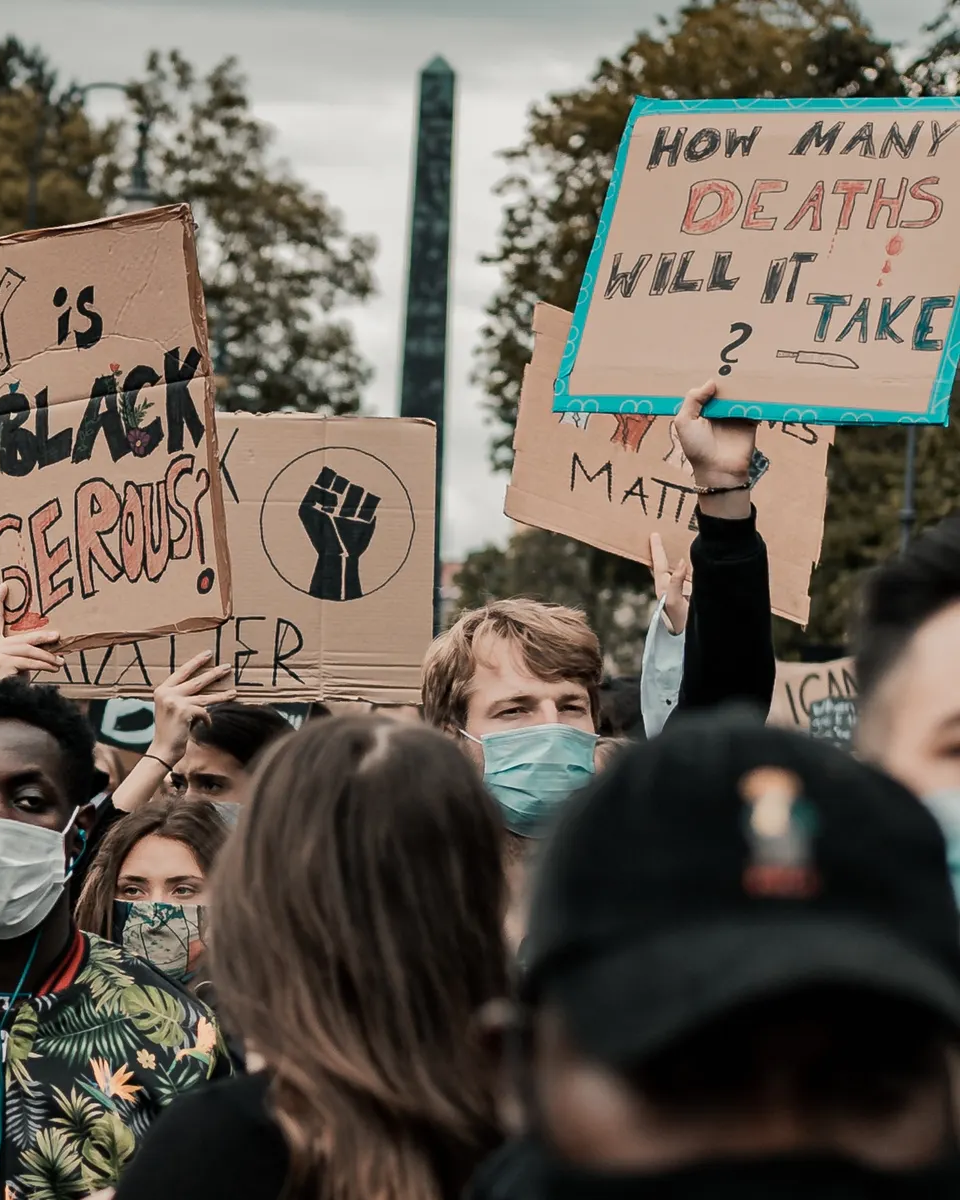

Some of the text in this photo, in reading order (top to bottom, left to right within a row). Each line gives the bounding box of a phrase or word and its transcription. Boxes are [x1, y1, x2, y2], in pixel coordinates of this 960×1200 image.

[646, 119, 960, 171] HOW MANY
[680, 175, 944, 236] DEATHS
[603, 250, 818, 305] WILL IT
[717, 321, 753, 377] ?
[806, 293, 955, 352] TAKE
